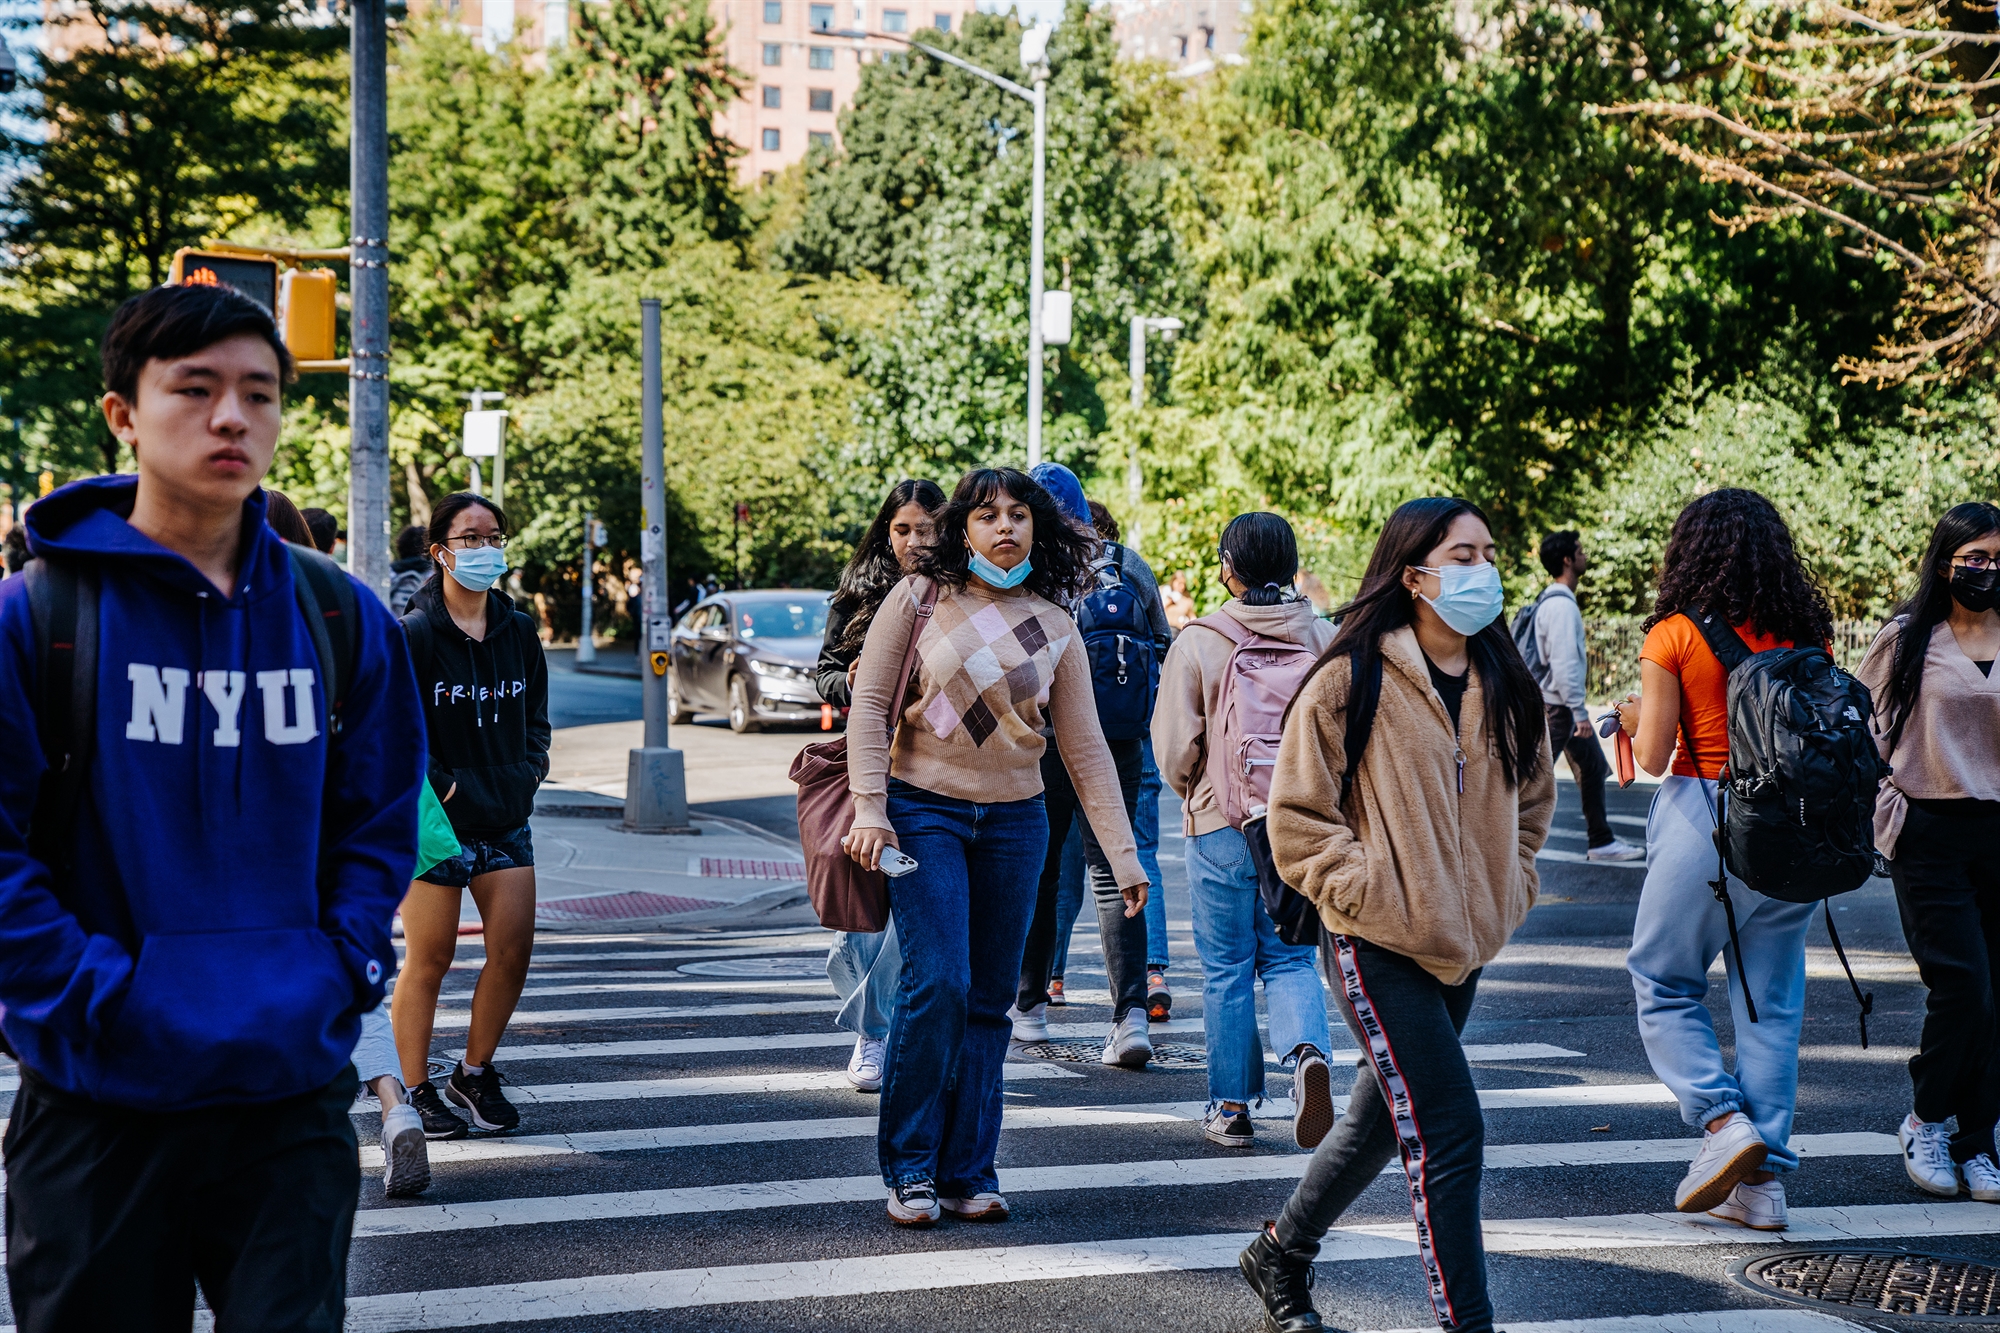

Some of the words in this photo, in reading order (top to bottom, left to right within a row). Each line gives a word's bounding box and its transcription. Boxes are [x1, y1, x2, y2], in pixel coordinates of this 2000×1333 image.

[125, 662, 321, 748] NYU
[1345, 968, 1361, 999] PINK
[1358, 1006, 1382, 1037] PINK
[1375, 1049, 1399, 1079] PINK
[1394, 1090, 1411, 1122] PINK
[1402, 1135, 1422, 1161] PINK
[1417, 1219, 1431, 1250] PINK
[1427, 1264, 1442, 1295] PINK
